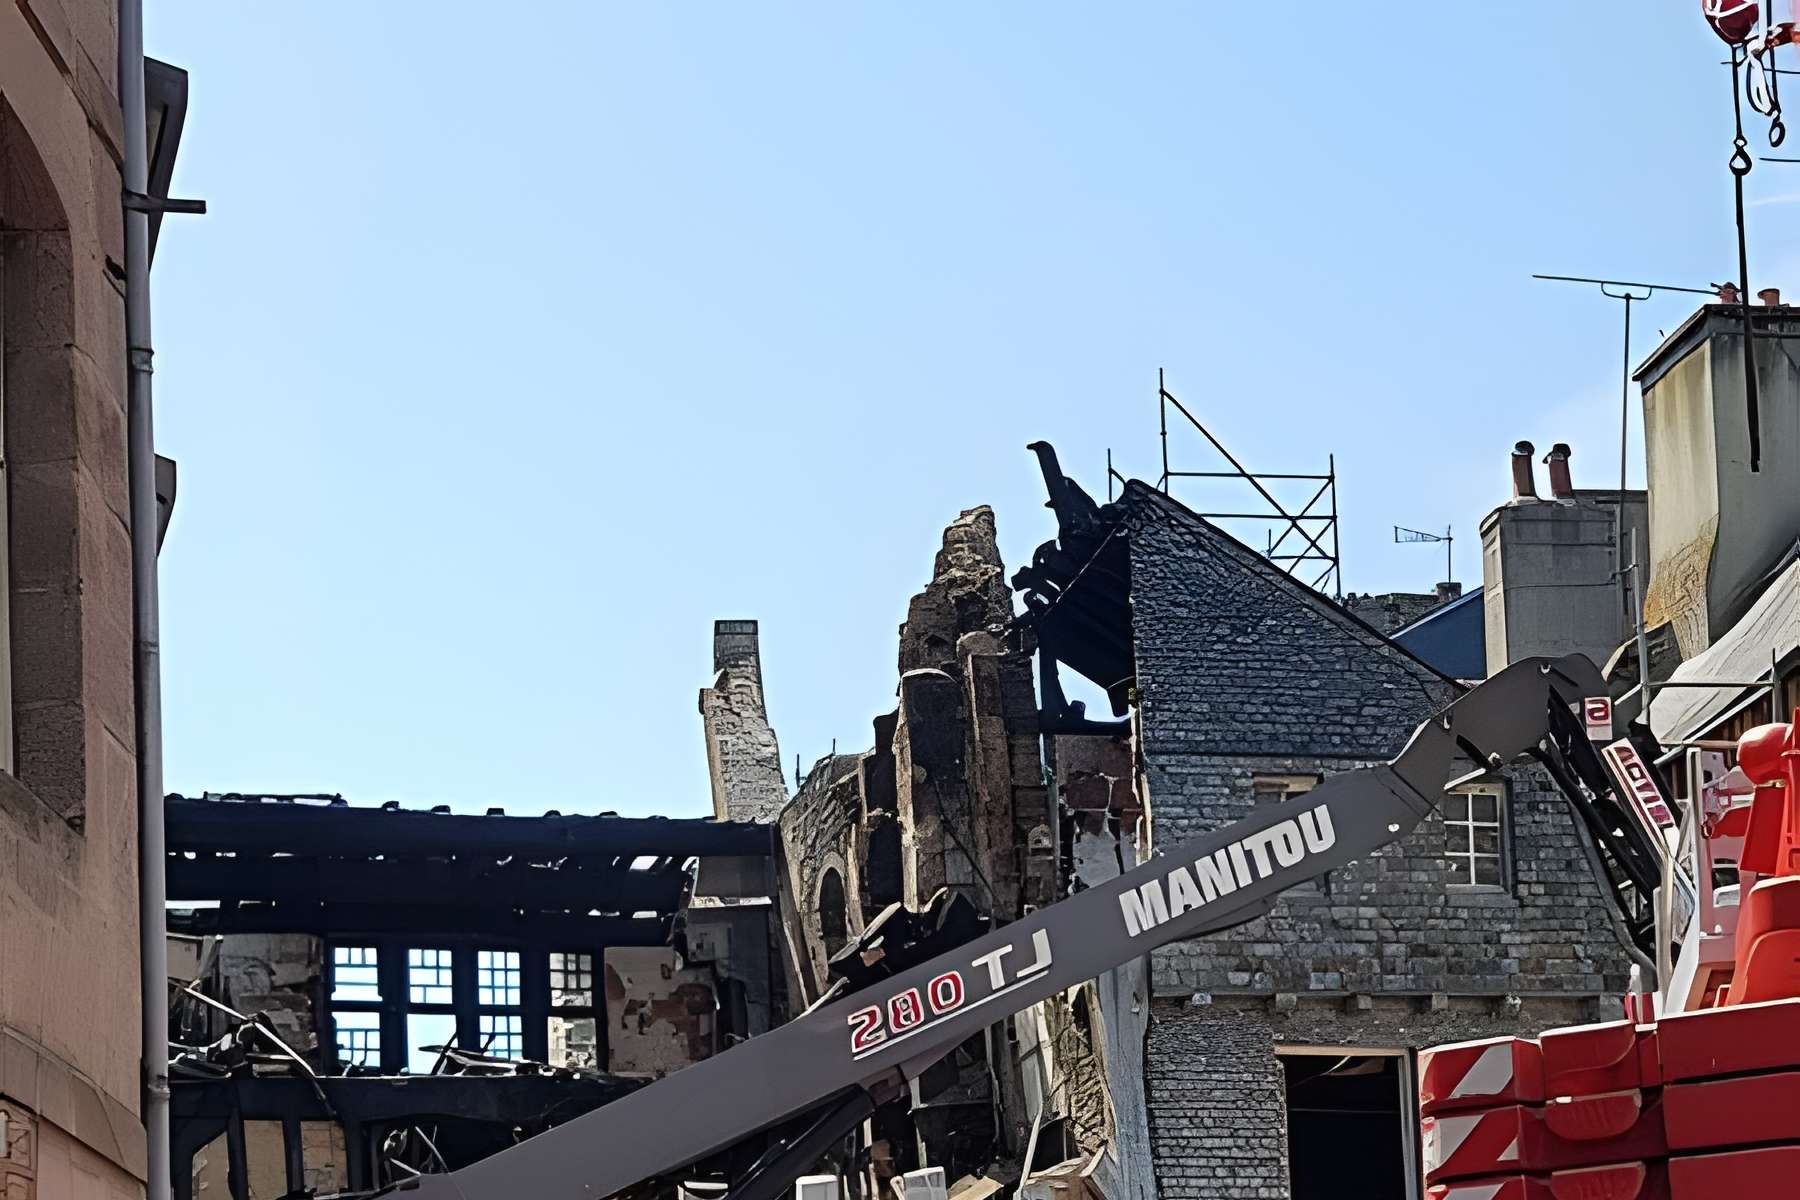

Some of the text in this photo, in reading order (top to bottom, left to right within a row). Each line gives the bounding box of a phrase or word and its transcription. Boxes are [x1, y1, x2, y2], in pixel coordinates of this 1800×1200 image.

[1118, 804, 1336, 937] MANITOU
[848, 928, 1053, 1053] 280 TJ
